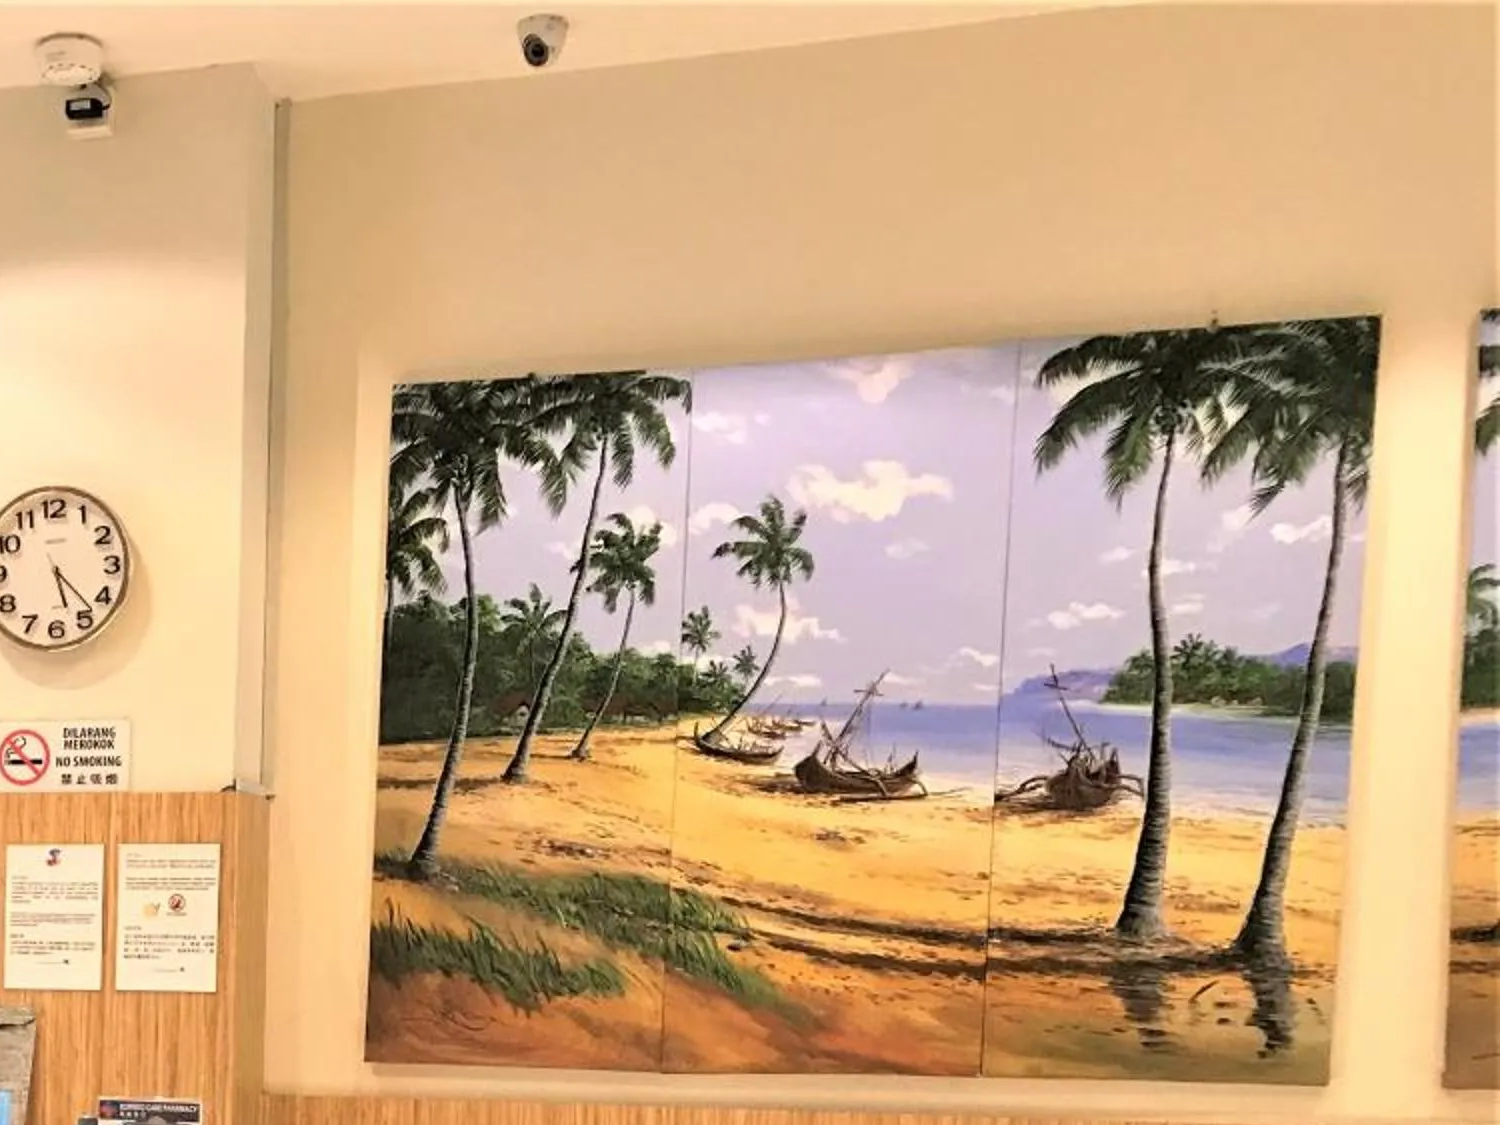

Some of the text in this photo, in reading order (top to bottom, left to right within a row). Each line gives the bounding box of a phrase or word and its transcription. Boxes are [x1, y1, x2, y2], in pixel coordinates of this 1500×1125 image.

[41, 499, 67, 519] 12
[78, 505, 87, 524] 1
[16, 509, 35, 529] 11
[94, 525, 111, 546] 2
[103, 555, 121, 574] 3
[94, 586, 112, 605] 4
[22, 614, 38, 634] 7
[48, 620, 65, 639] 6
[76, 610, 93, 630] 5
[63, 726, 116, 739] DILARANG
[63, 739, 115, 751] MEROKOK
[56, 755, 122, 768] NO SMOKING
